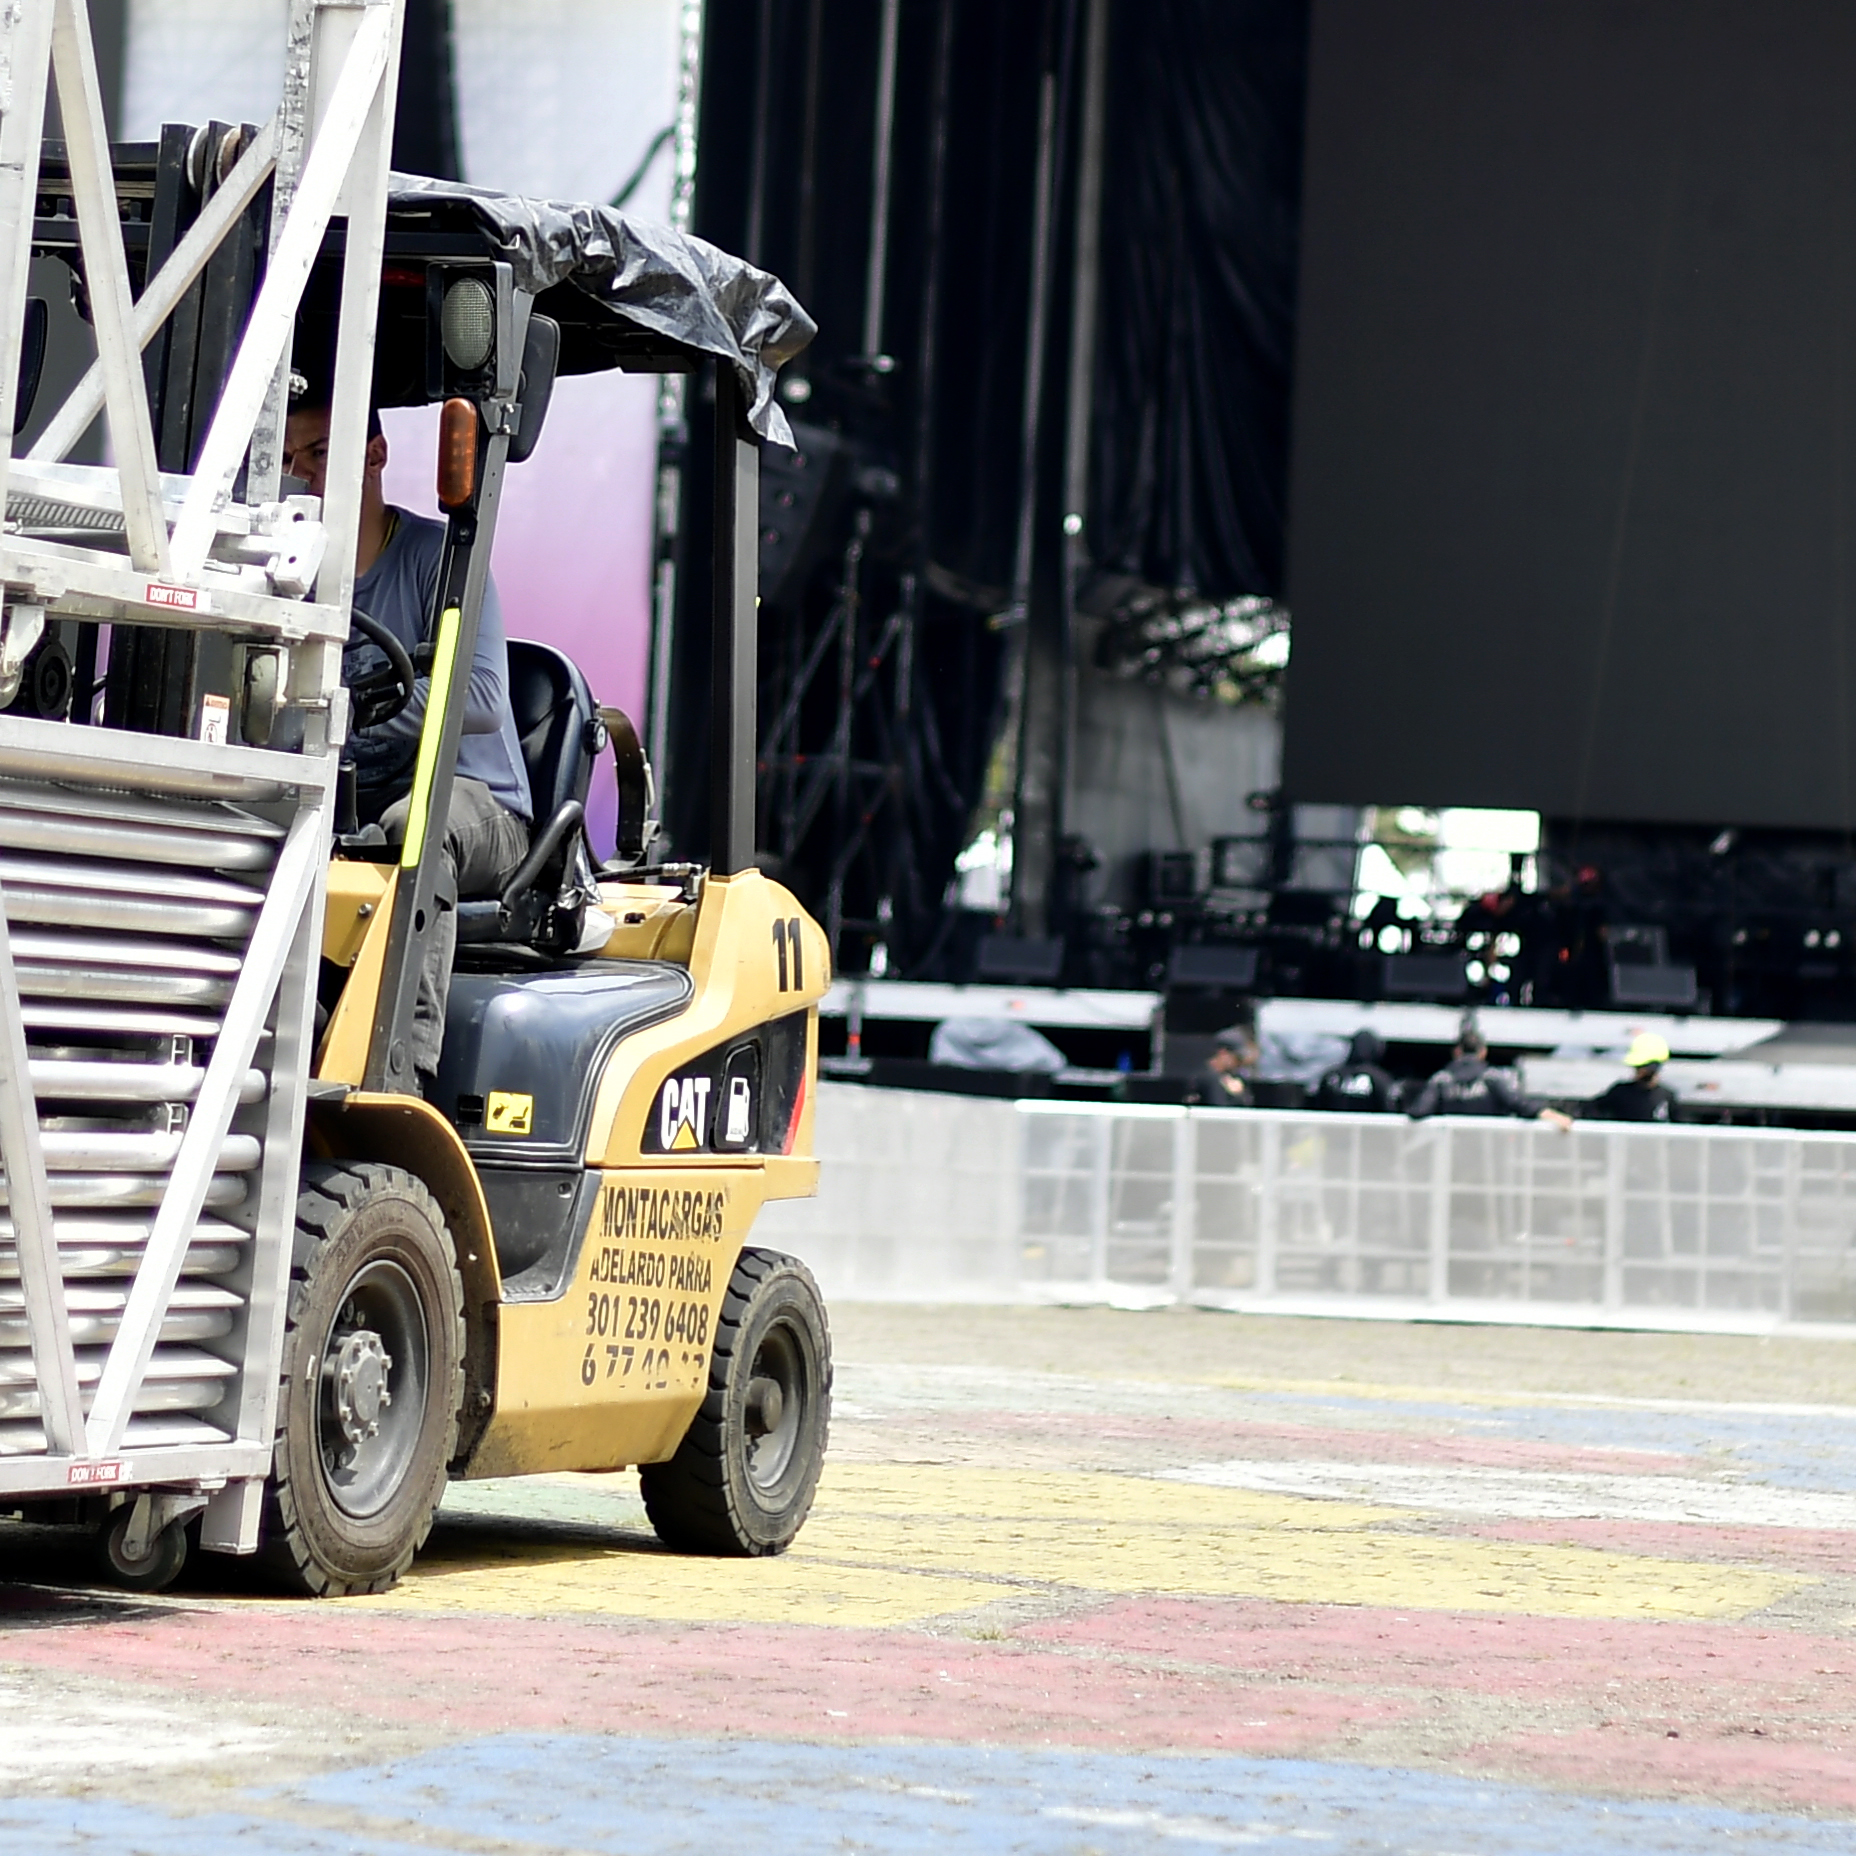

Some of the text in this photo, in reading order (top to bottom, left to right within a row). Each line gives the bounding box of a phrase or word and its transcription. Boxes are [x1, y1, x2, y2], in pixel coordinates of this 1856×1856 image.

[174, 590, 195, 606] FORK
[772, 918, 804, 992] 11
[661, 1077, 711, 1150] CAT
[600, 1186, 725, 1243] MONTACARGAS
[590, 1247, 712, 1294] ADELARDO PARRA
[586, 1292, 710, 1346] 301 239 6408
